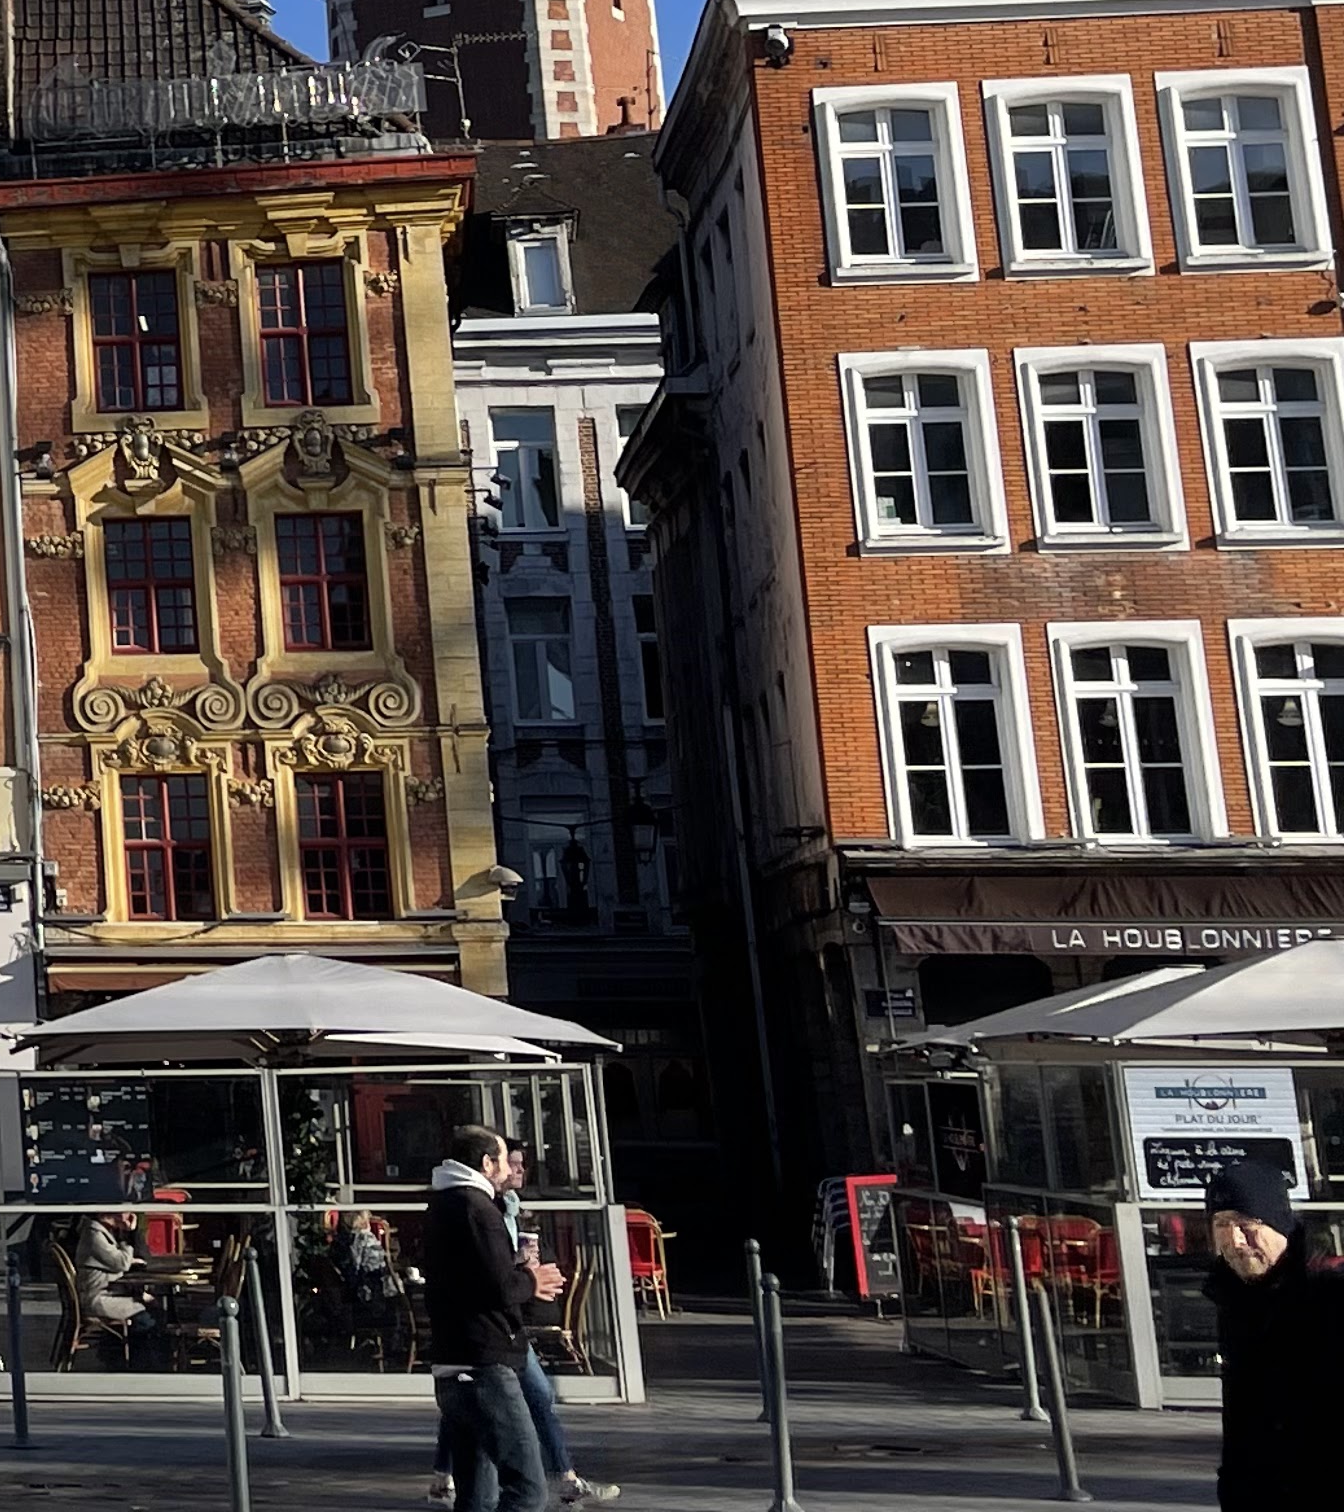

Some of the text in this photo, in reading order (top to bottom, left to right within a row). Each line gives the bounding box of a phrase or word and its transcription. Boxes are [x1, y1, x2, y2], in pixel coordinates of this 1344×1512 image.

[1051, 928, 1332, 950] LA HOUBLONNIER
[1174, 1114, 1258, 1125] PLAT DU JOUR
